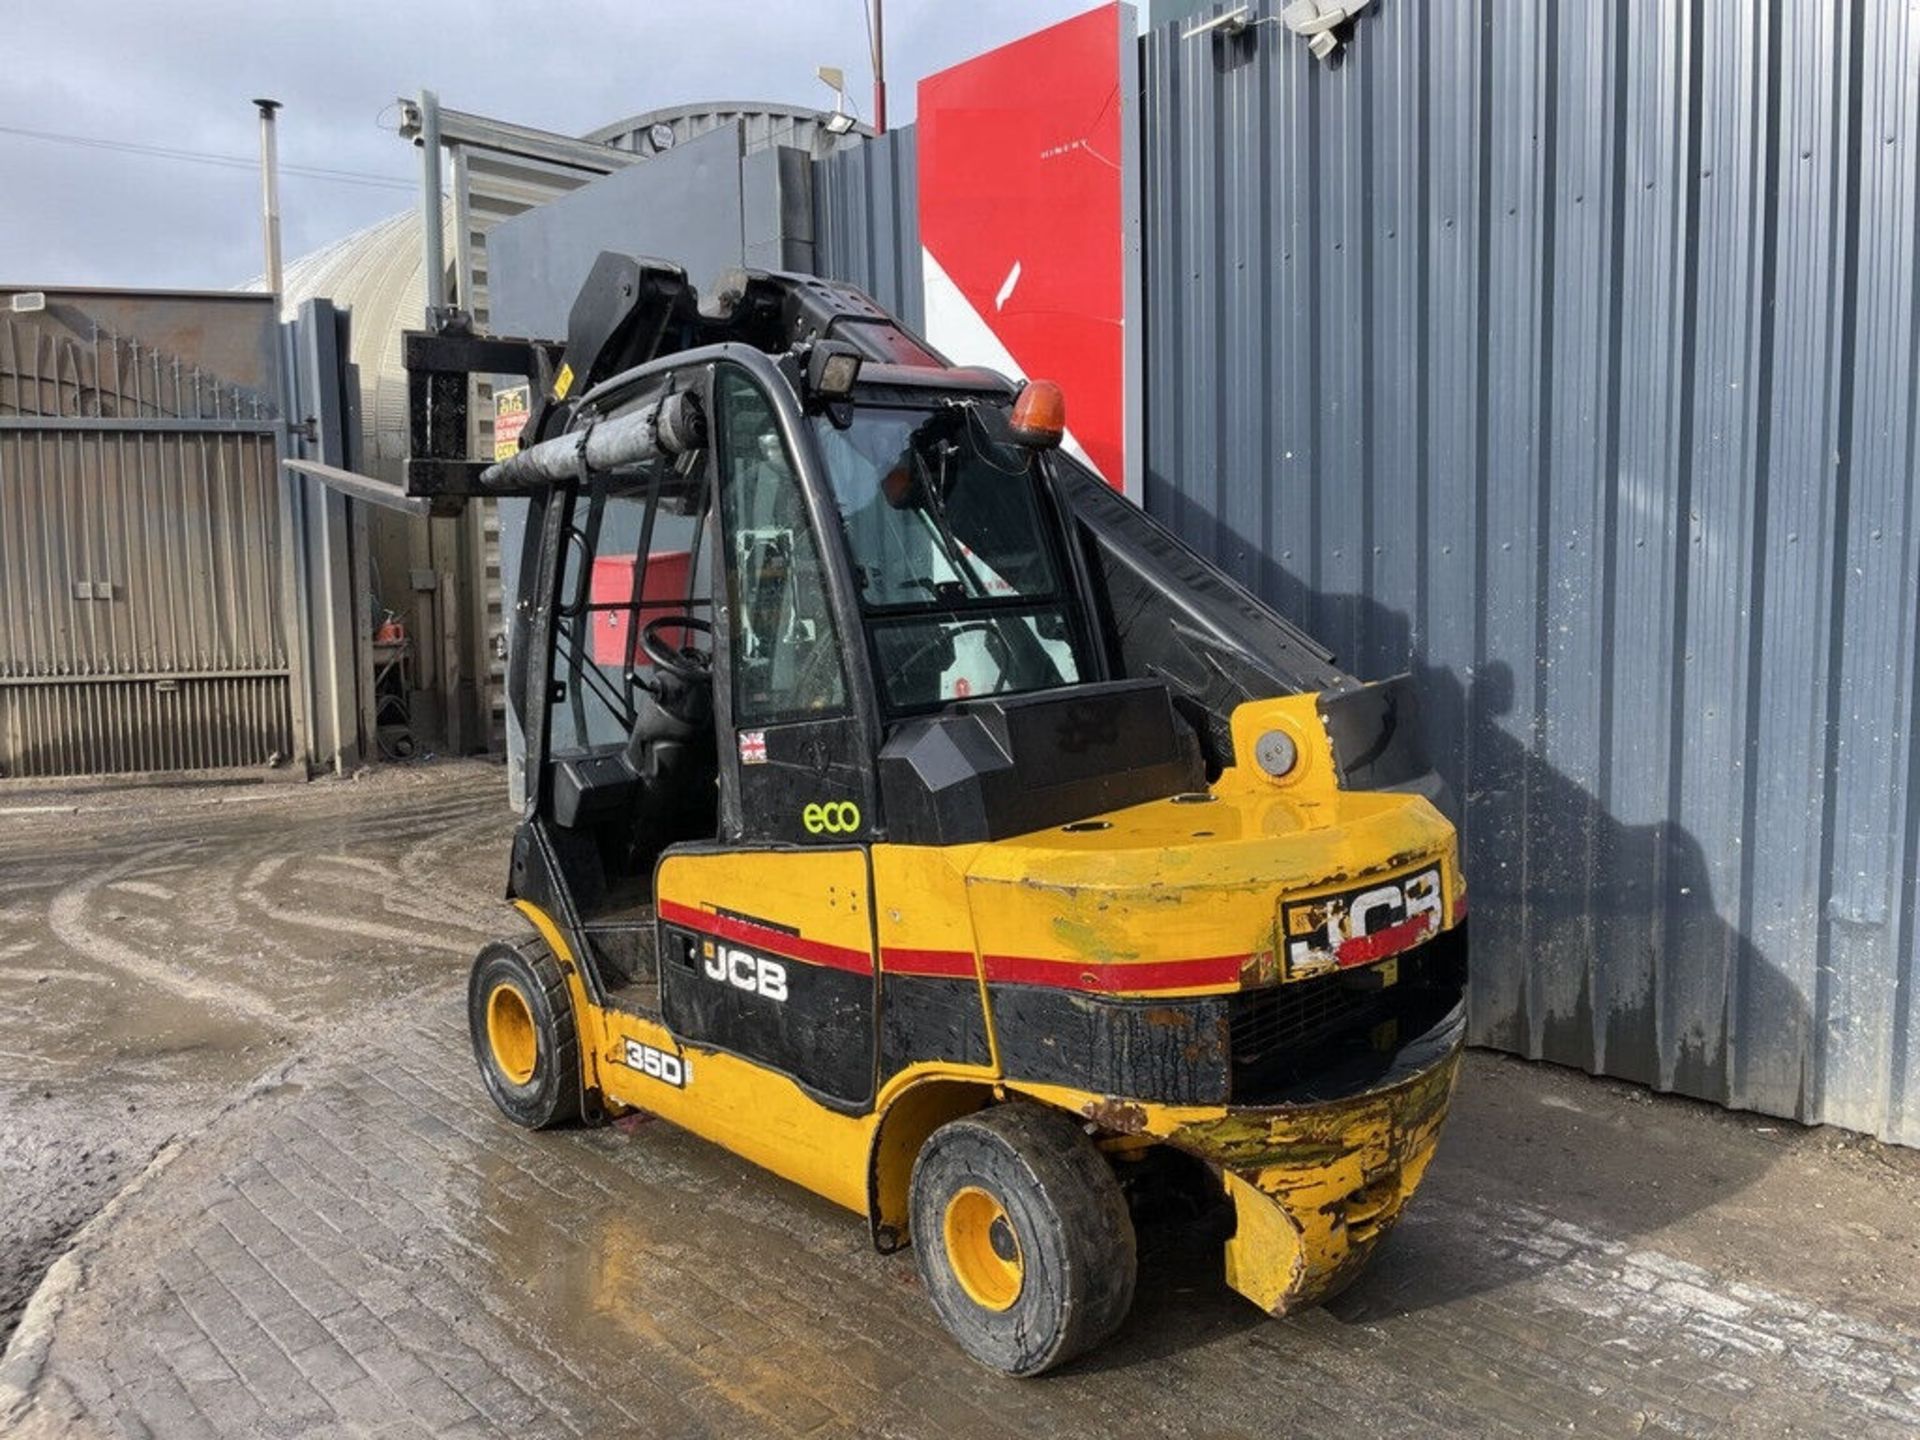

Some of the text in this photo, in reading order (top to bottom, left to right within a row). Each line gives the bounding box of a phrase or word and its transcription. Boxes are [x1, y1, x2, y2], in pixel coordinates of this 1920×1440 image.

[803, 801, 861, 833] eco
[704, 945, 788, 1002] JCB
[625, 1039, 682, 1086] 35D
